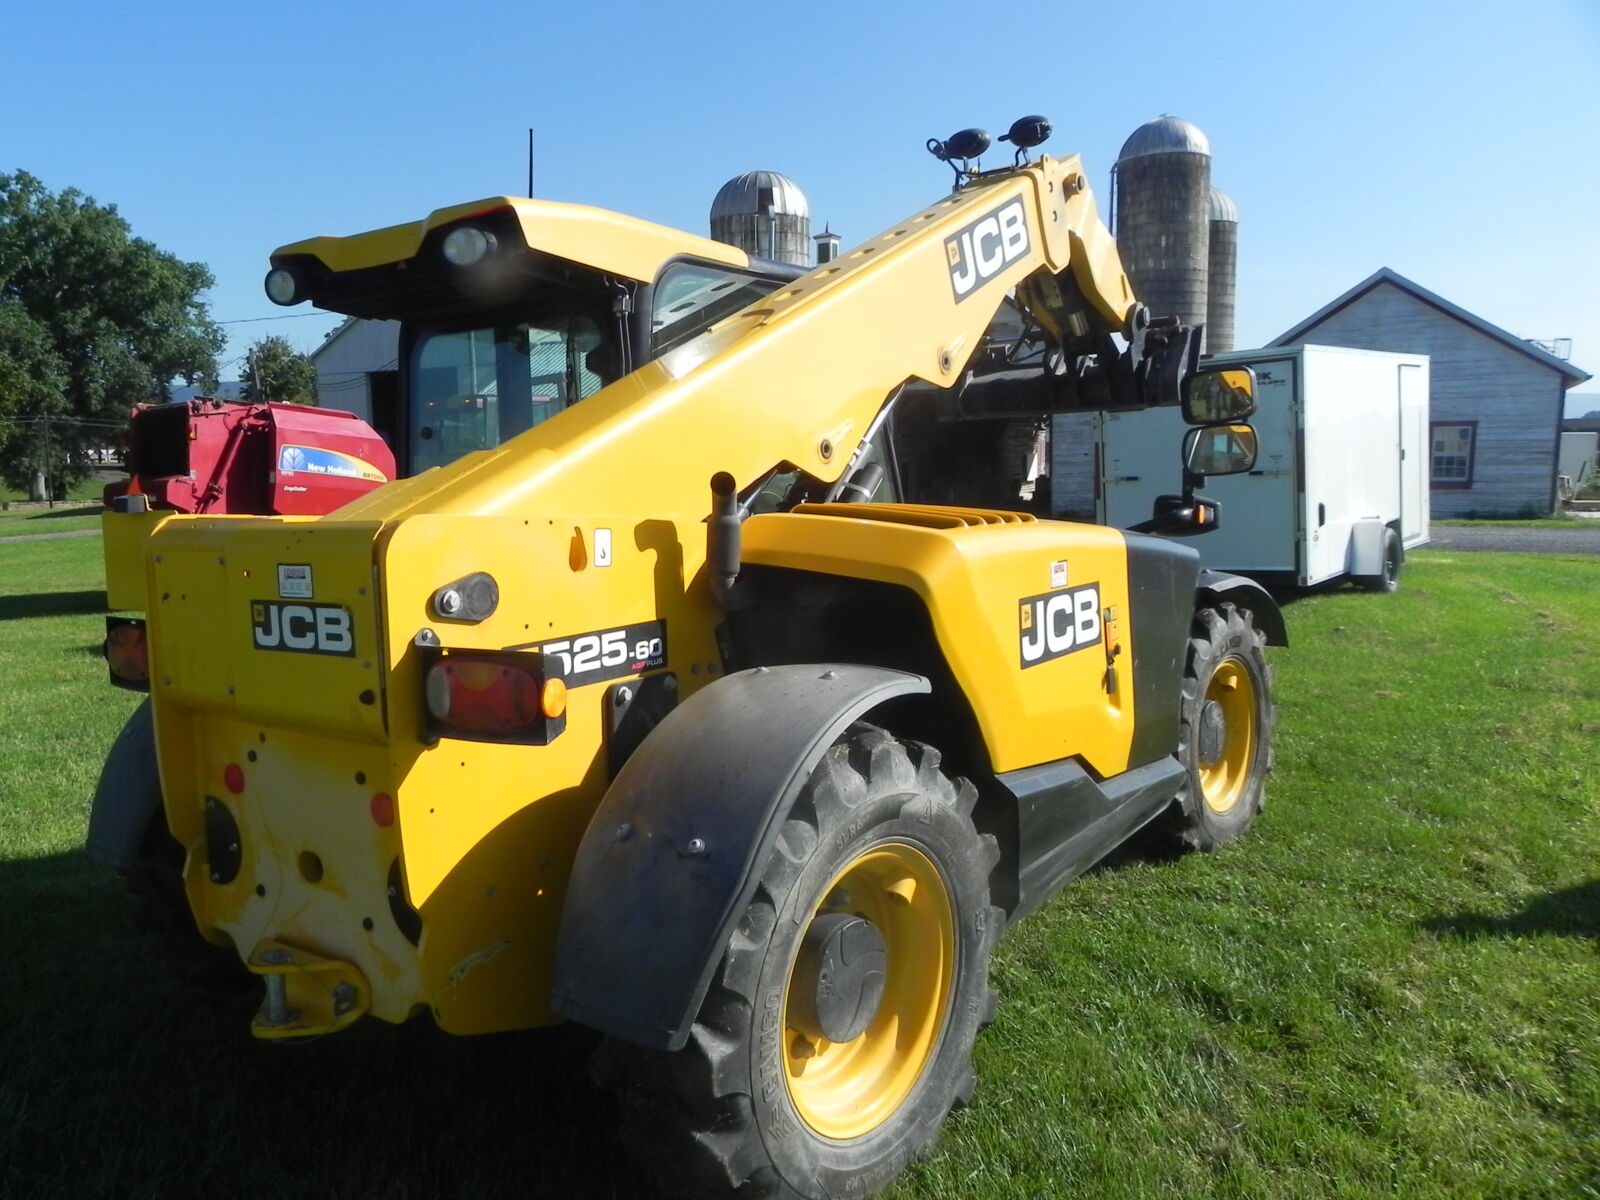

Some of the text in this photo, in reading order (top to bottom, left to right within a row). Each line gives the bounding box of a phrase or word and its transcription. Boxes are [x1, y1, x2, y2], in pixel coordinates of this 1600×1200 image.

[952, 201, 1028, 295] JCB
[307, 462, 326, 473] New
[327, 464, 357, 476] Holland
[255, 604, 353, 652] JCB
[1021, 588, 1101, 662] JCB
[543, 630, 663, 676] 525-60
[646, 657, 663, 667] PLUS
